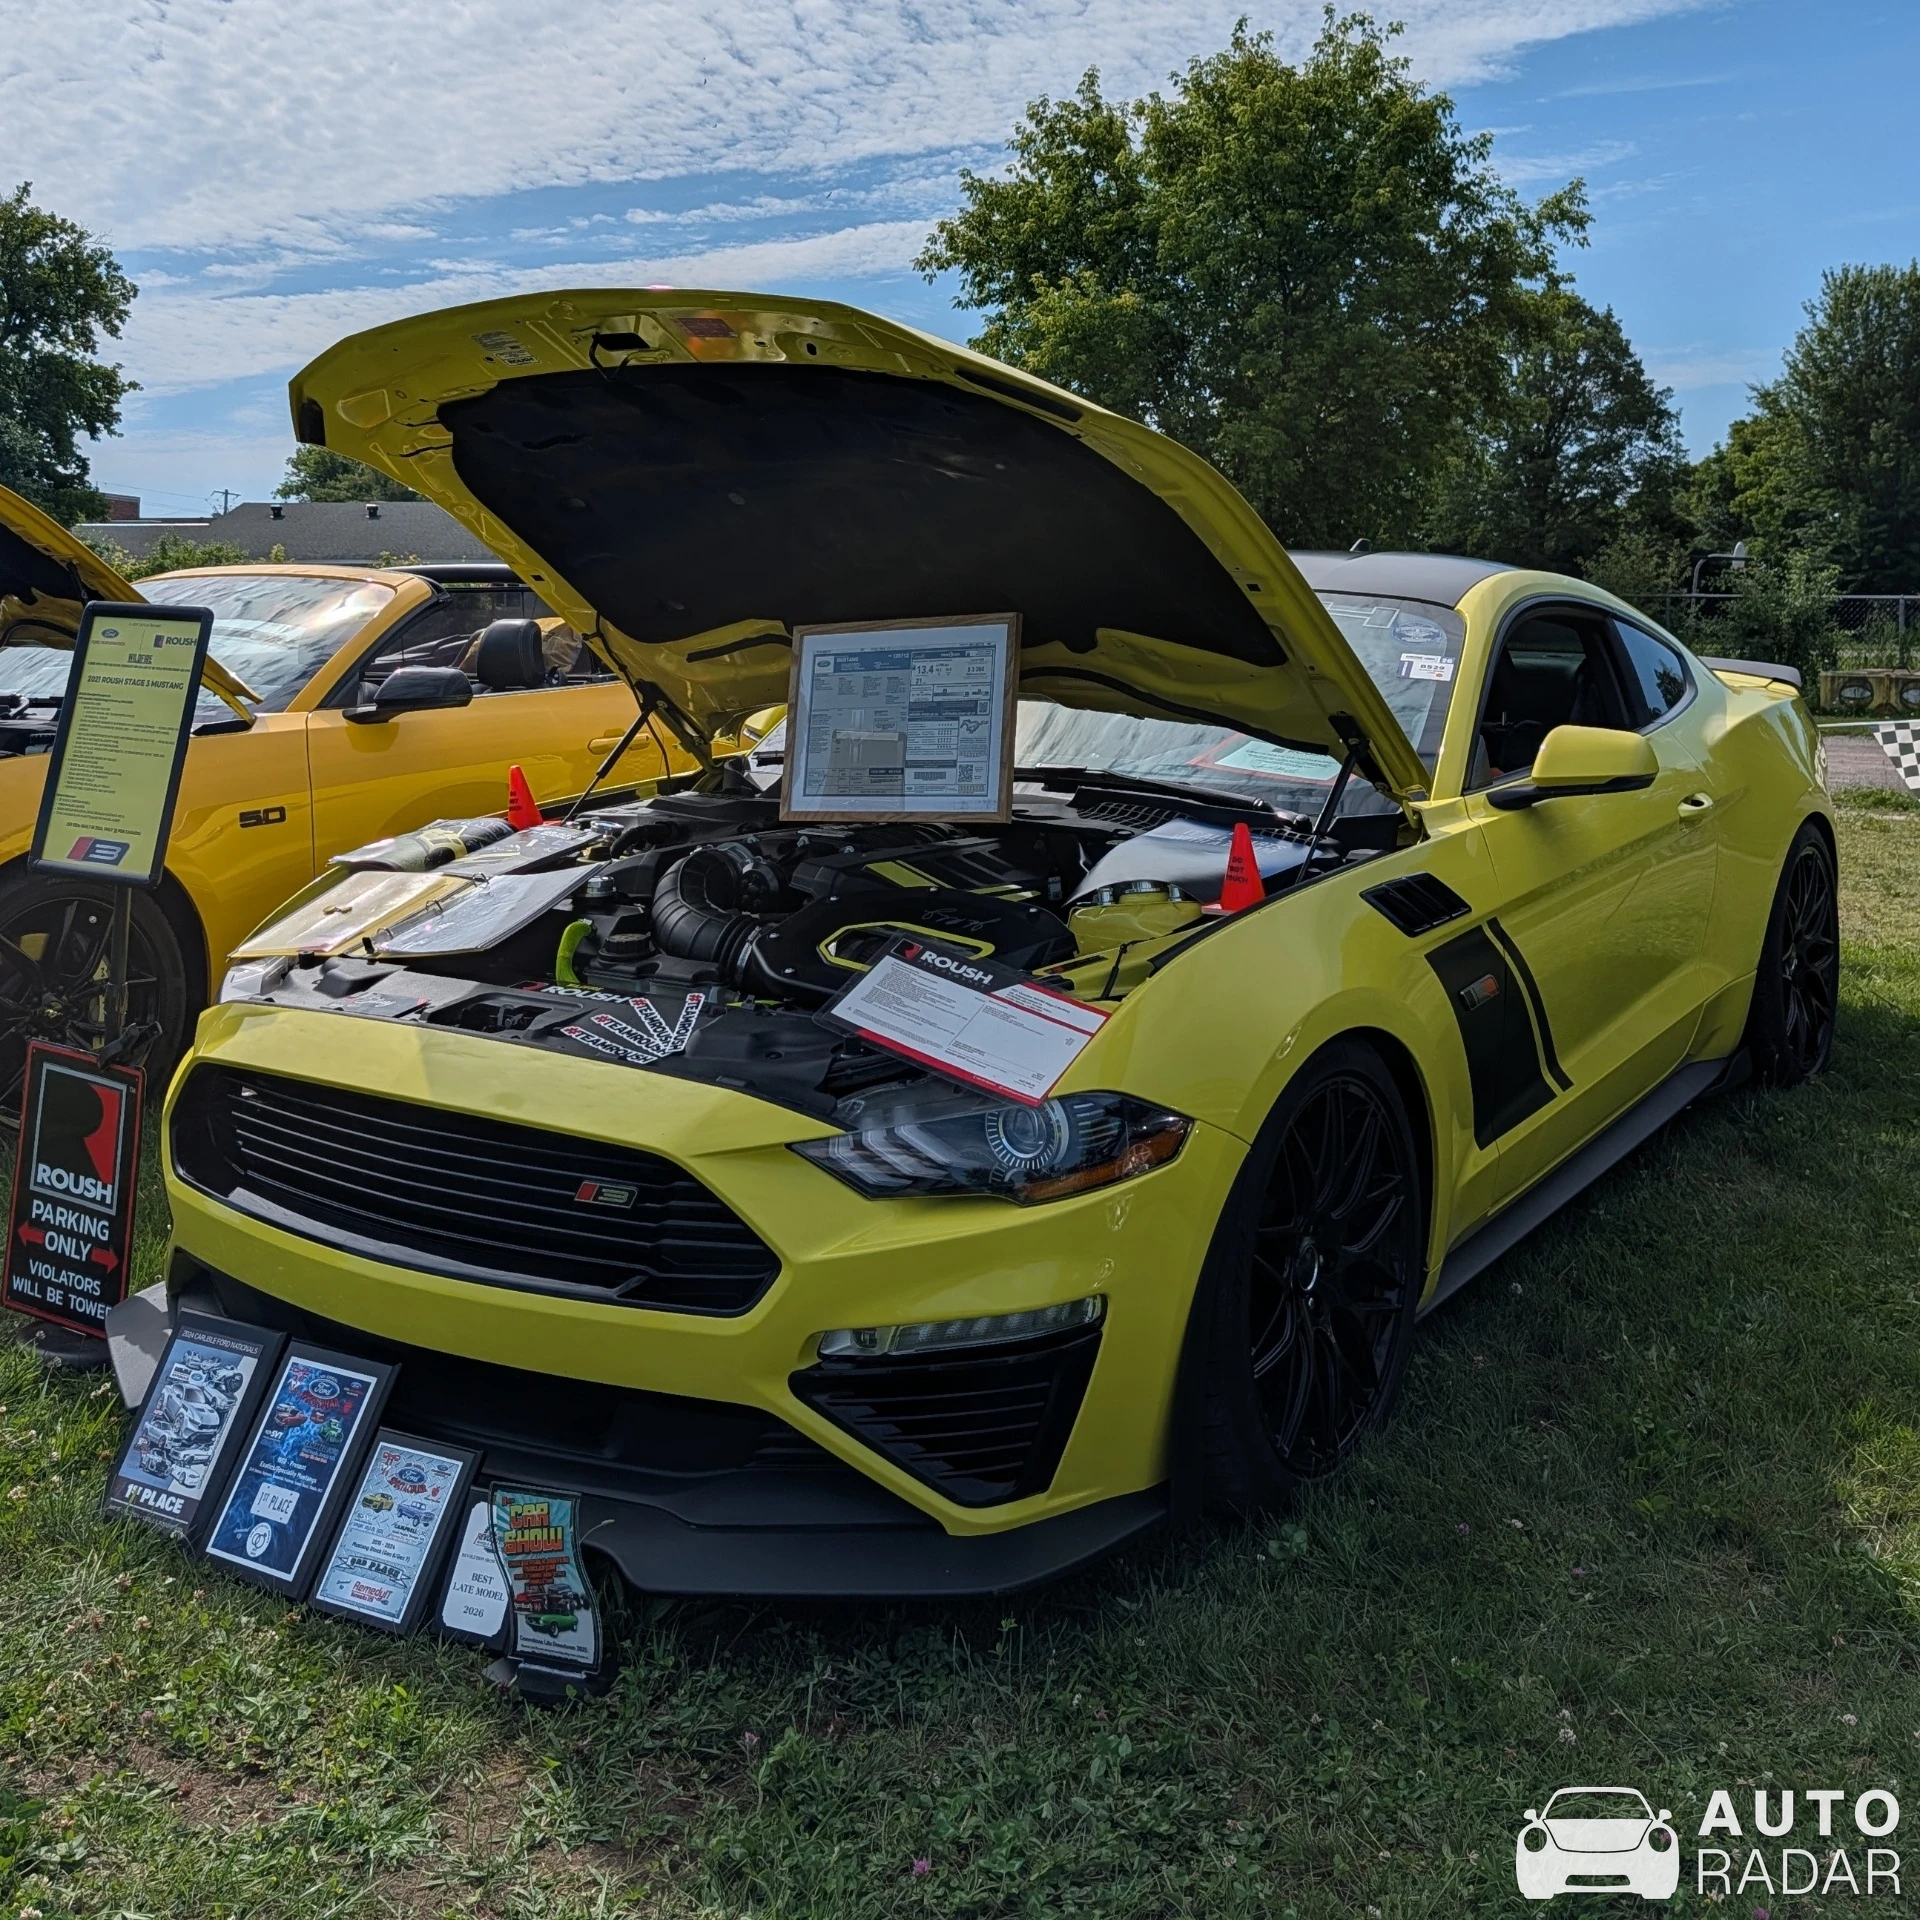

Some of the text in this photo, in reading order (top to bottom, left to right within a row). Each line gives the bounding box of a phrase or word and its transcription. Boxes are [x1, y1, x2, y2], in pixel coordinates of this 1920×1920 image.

[166, 636, 197, 646] ROUSH
[128, 654, 153, 664] WILDFIRE
[917, 665, 934, 674] 13.4
[87, 675, 184, 690] 2021 ROUSH STAGE 3 MUSTANG
[1226, 875, 1248, 883] TOUCH
[920, 950, 994, 985] ROUSH
[541, 985, 631, 1003] ROUSH
[670, 994, 704, 1050] #TEAMROUSH
[564, 1026, 654, 1063] #TEAMROUSH
[36, 1163, 112, 1204] ROUSH
[32, 1199, 110, 1241] PARKING
[44, 1231, 92, 1262] ONLY
[29, 1259, 101, 1296] VIOLATORS
[12, 1275, 42, 1299] WILL
[47, 1287, 64, 1306] BE
[182, 1330, 258, 1354] 2024 CARLISLE FORD NATIONALS
[314, 1382, 333, 1395] Ford
[402, 1470, 420, 1482] Ford
[140, 1488, 184, 1514] PLACE
[258, 1492, 292, 1514] 1ST PLACE
[510, 1502, 550, 1530] CAR
[504, 1526, 564, 1556] SHOW
[369, 1562, 401, 1578] PLACE
[472, 1572, 494, 1585] BEST
[352, 1580, 393, 1599] RemedyIT
[453, 1582, 504, 1601] LATE MODEL
[463, 1606, 484, 1618] 2026
